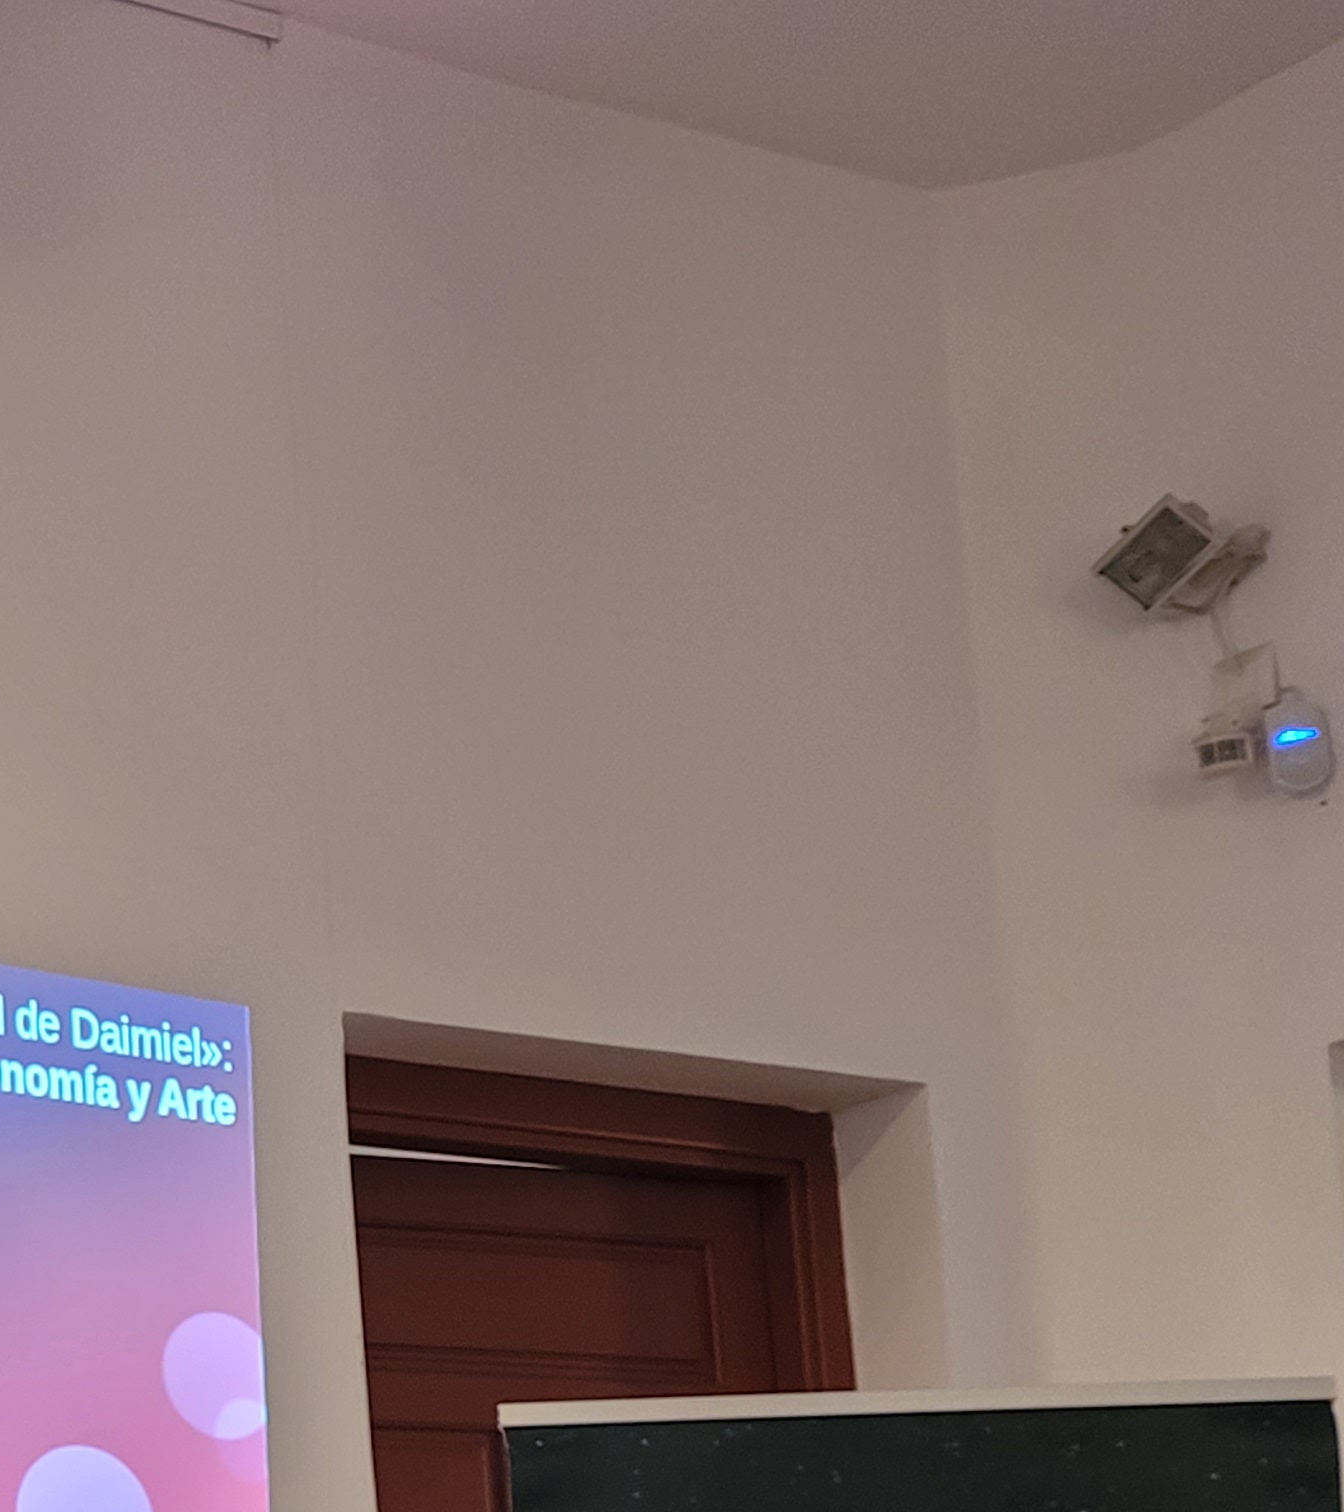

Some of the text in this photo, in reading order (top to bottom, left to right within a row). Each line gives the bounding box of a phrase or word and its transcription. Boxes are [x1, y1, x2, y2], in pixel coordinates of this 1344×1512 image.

[15, 999, 61, 1044] de
[71, 1007, 233, 1072] Daimiel»:
[126, 1079, 151, 1122] y
[158, 1078, 236, 1125] Arte
